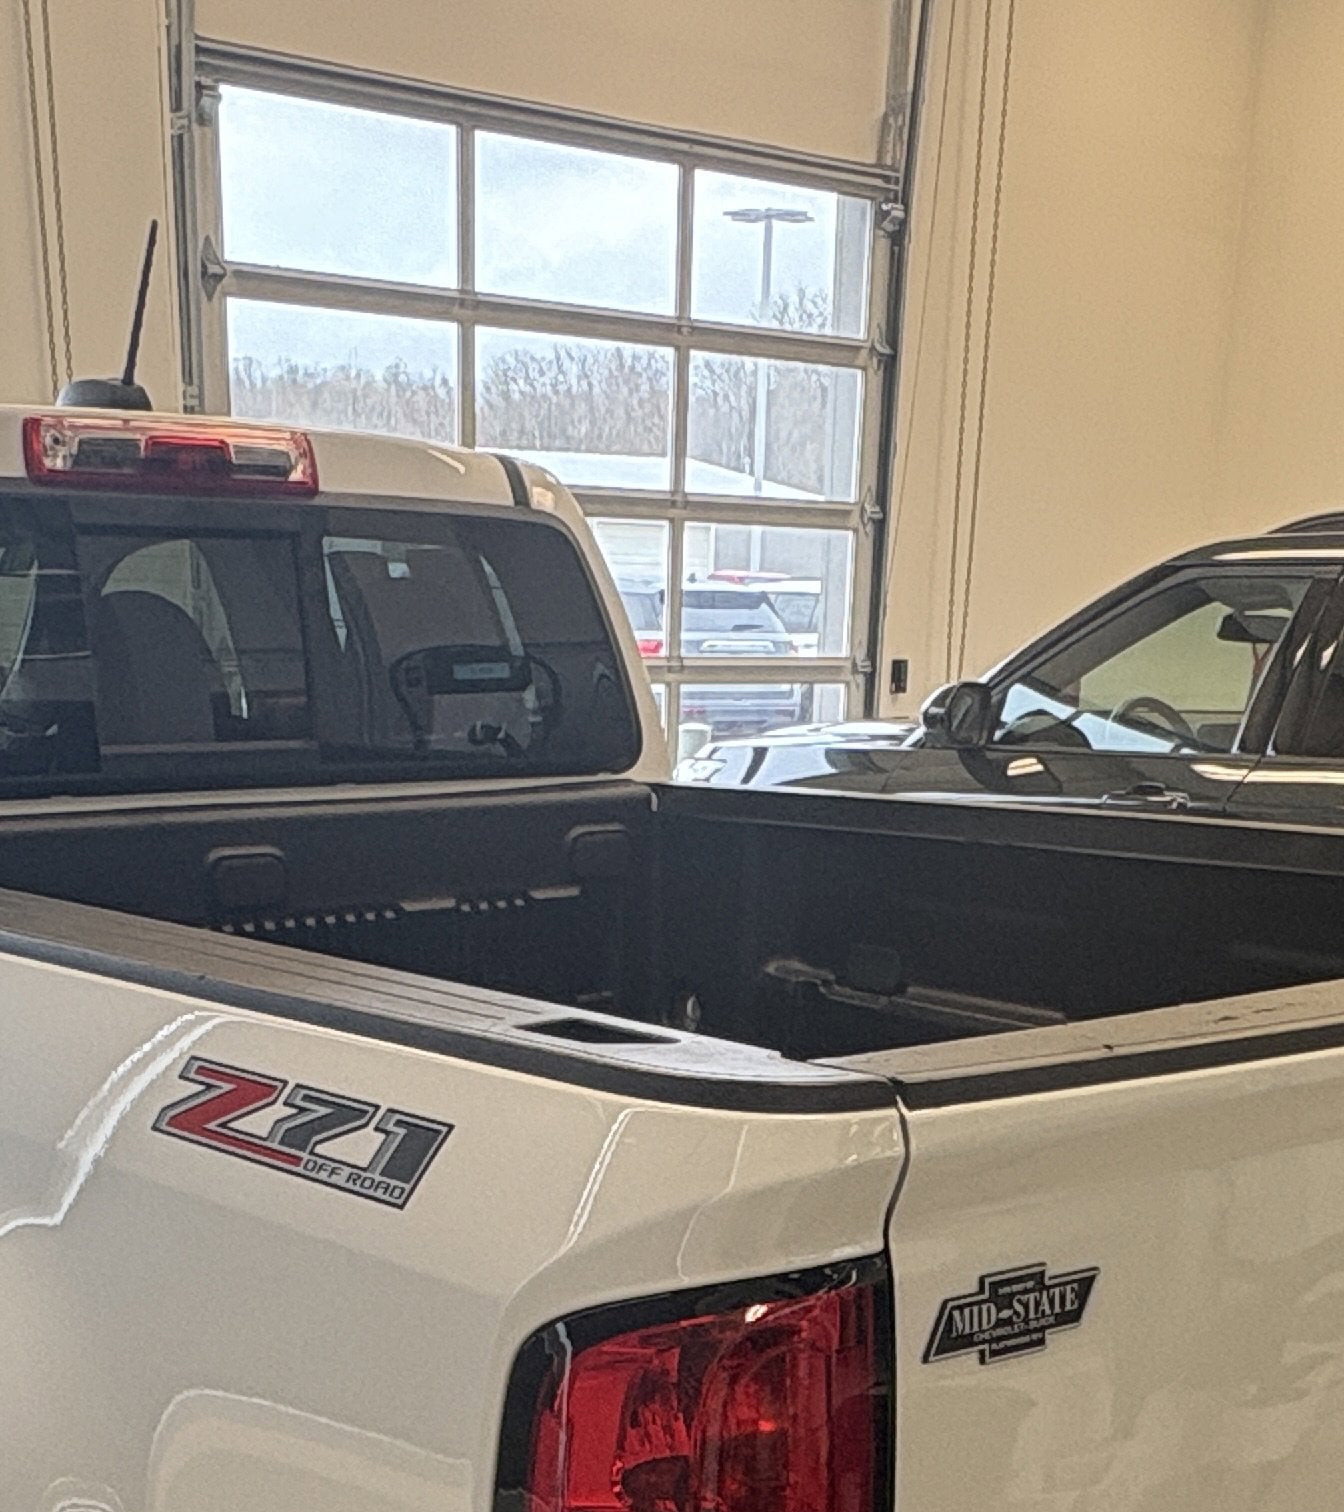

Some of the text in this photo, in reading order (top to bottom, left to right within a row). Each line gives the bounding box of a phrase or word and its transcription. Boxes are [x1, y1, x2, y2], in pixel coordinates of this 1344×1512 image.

[152, 1055, 455, 1194] Z71
[302, 1158, 406, 1200] OFF ROAD
[949, 1282, 1080, 1339] MID-STATE
